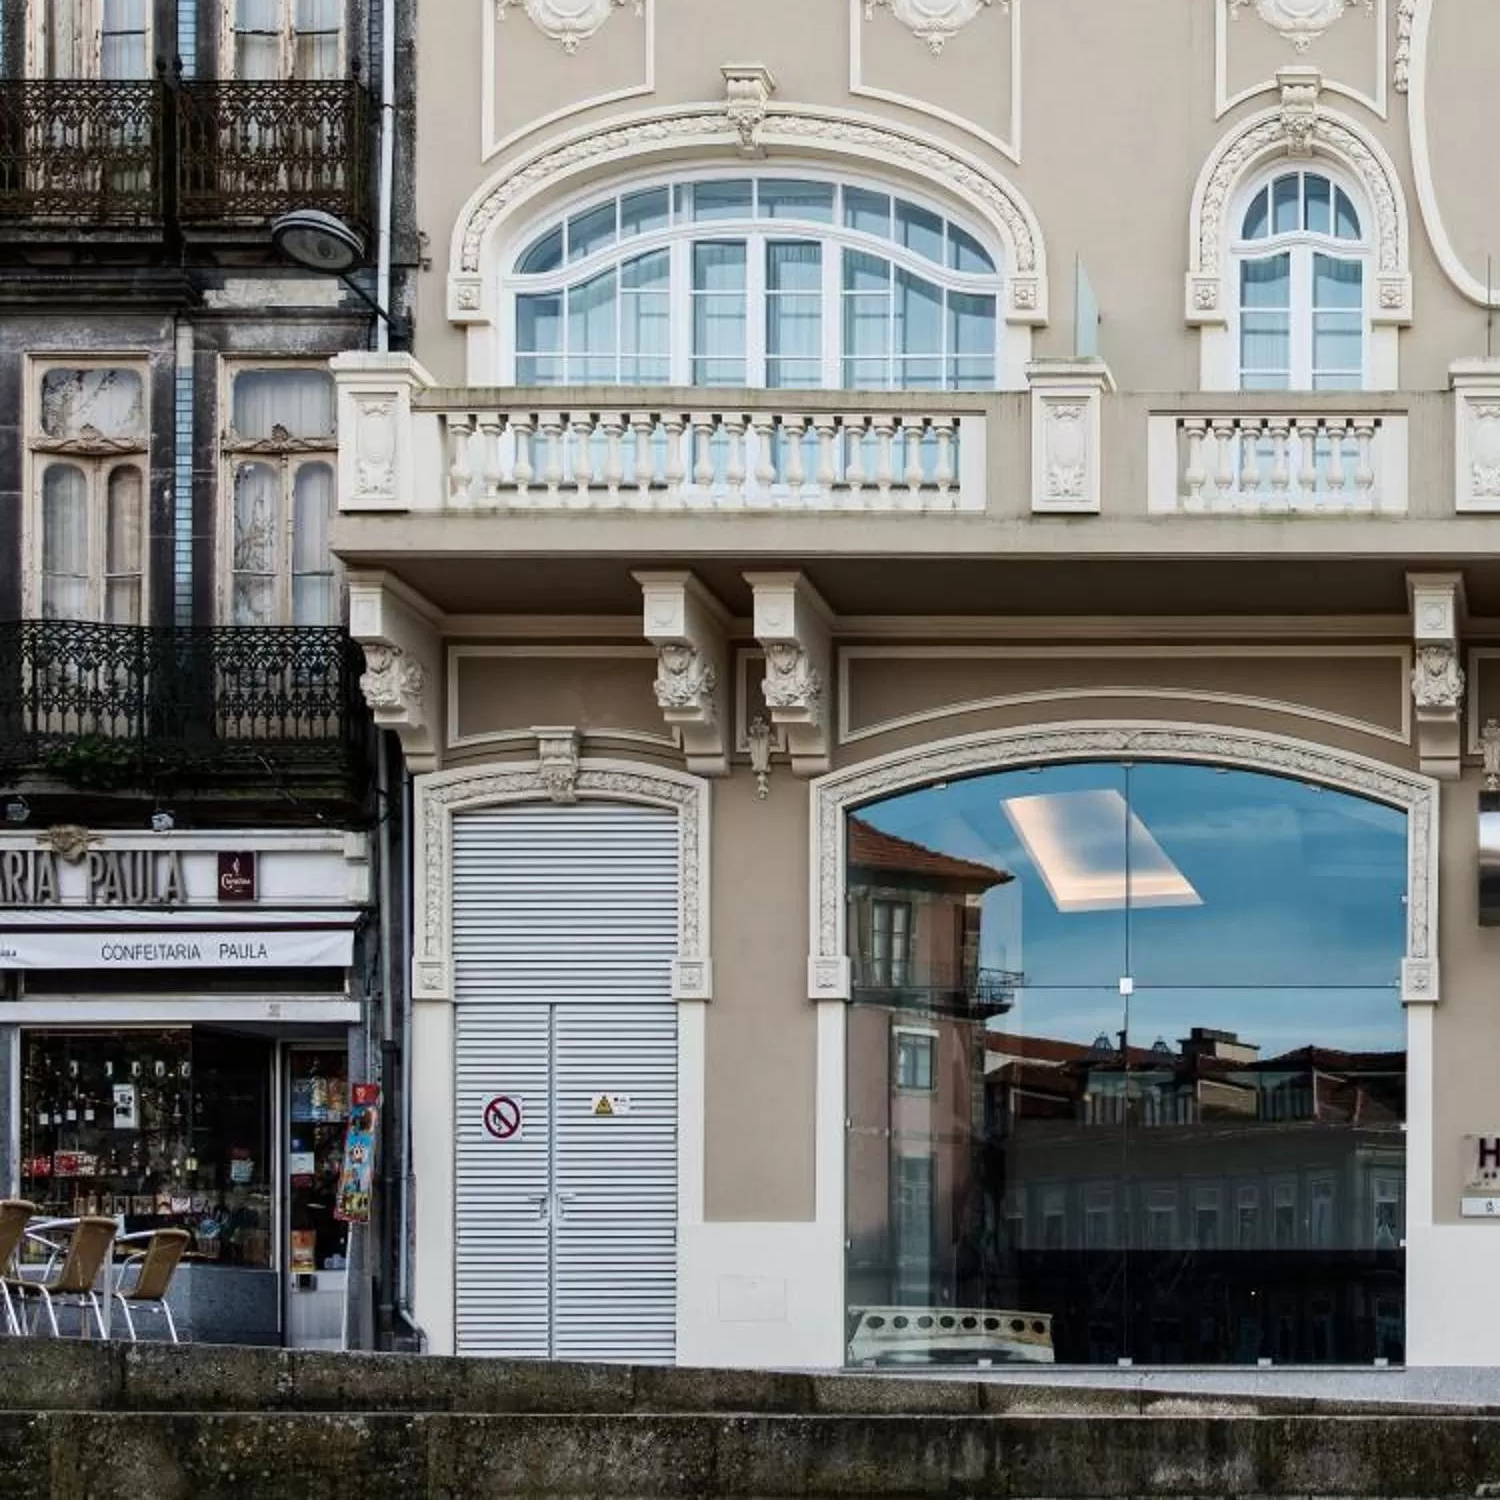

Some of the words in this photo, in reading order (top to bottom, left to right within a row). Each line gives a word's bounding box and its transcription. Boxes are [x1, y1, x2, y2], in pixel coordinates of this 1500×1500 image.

[0, 850, 57, 903] RIA
[86, 851, 186, 904] PAULA
[101, 942, 201, 962] CONFEITARIA
[219, 942, 269, 960] PAULA
